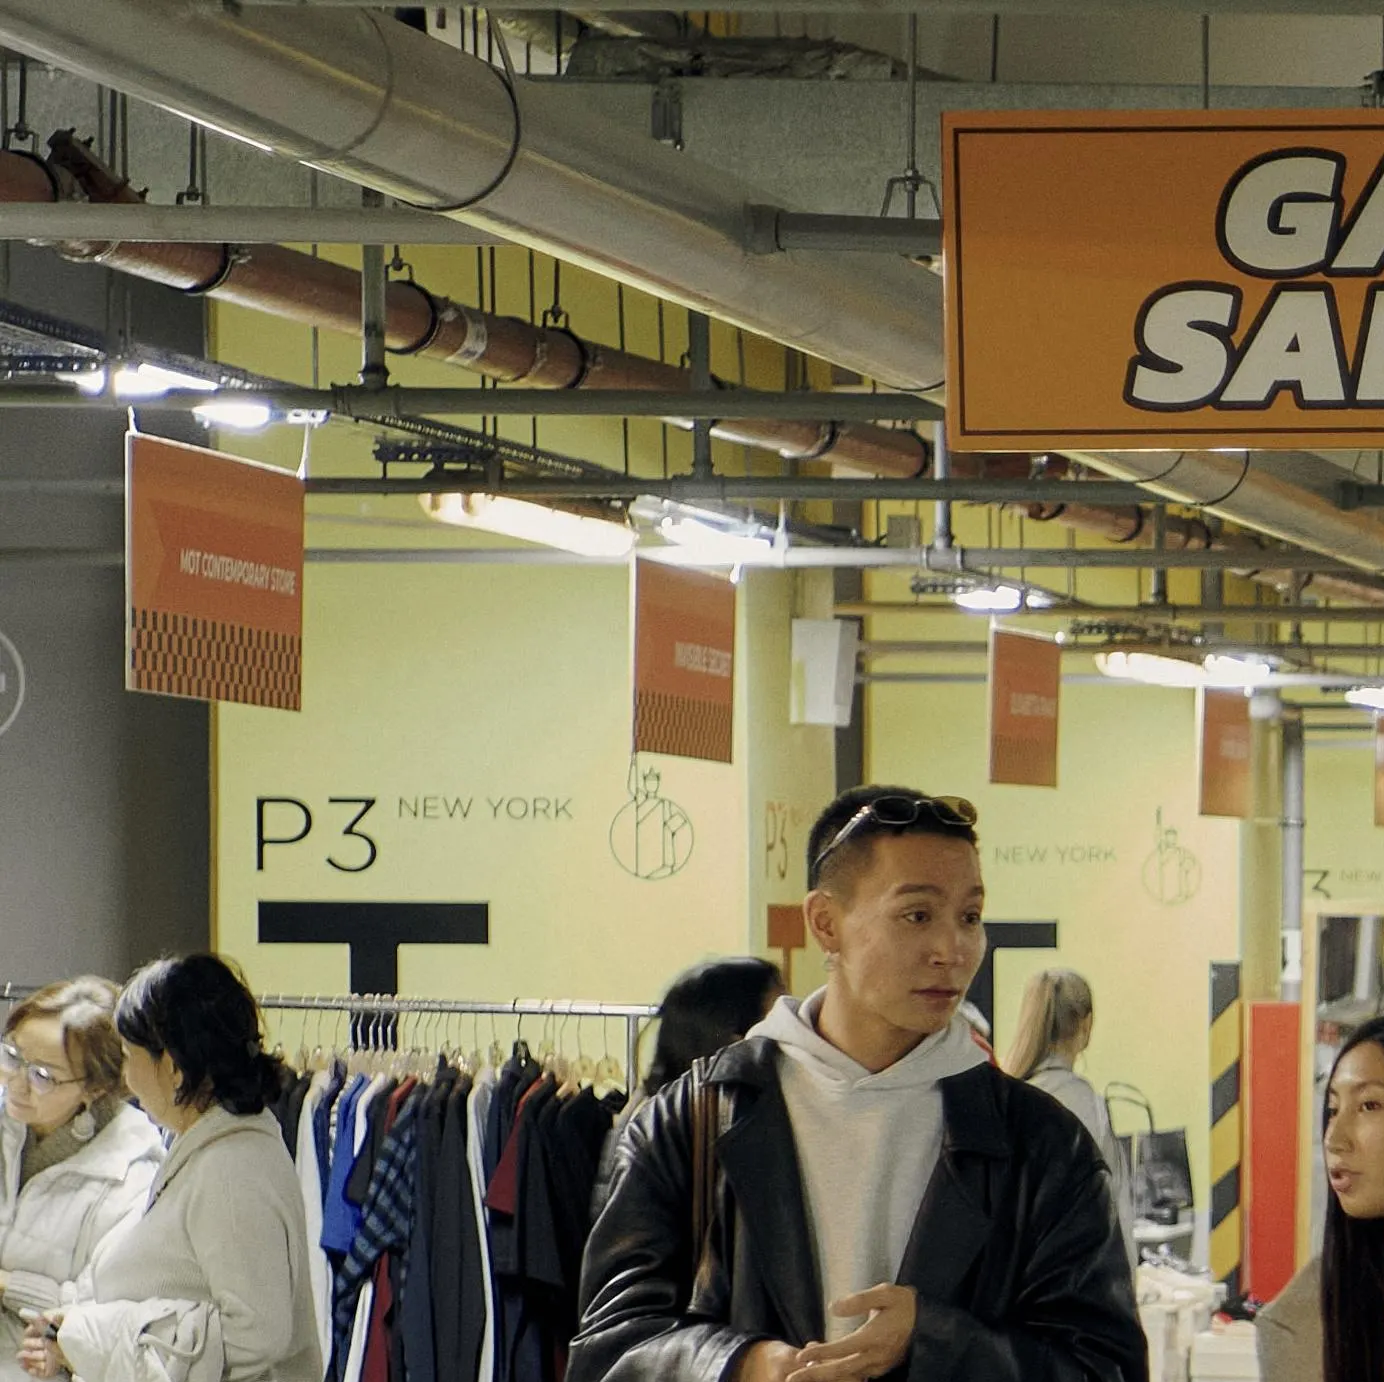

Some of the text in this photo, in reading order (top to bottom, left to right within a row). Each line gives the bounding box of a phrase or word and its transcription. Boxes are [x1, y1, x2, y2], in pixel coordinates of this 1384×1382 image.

[202, 551, 270, 589] CONTEMPORARY
[270, 566, 296, 595] STORE
[255, 796, 575, 873] P3 NEW YORK
[994, 845, 1118, 865] NEW YORK
